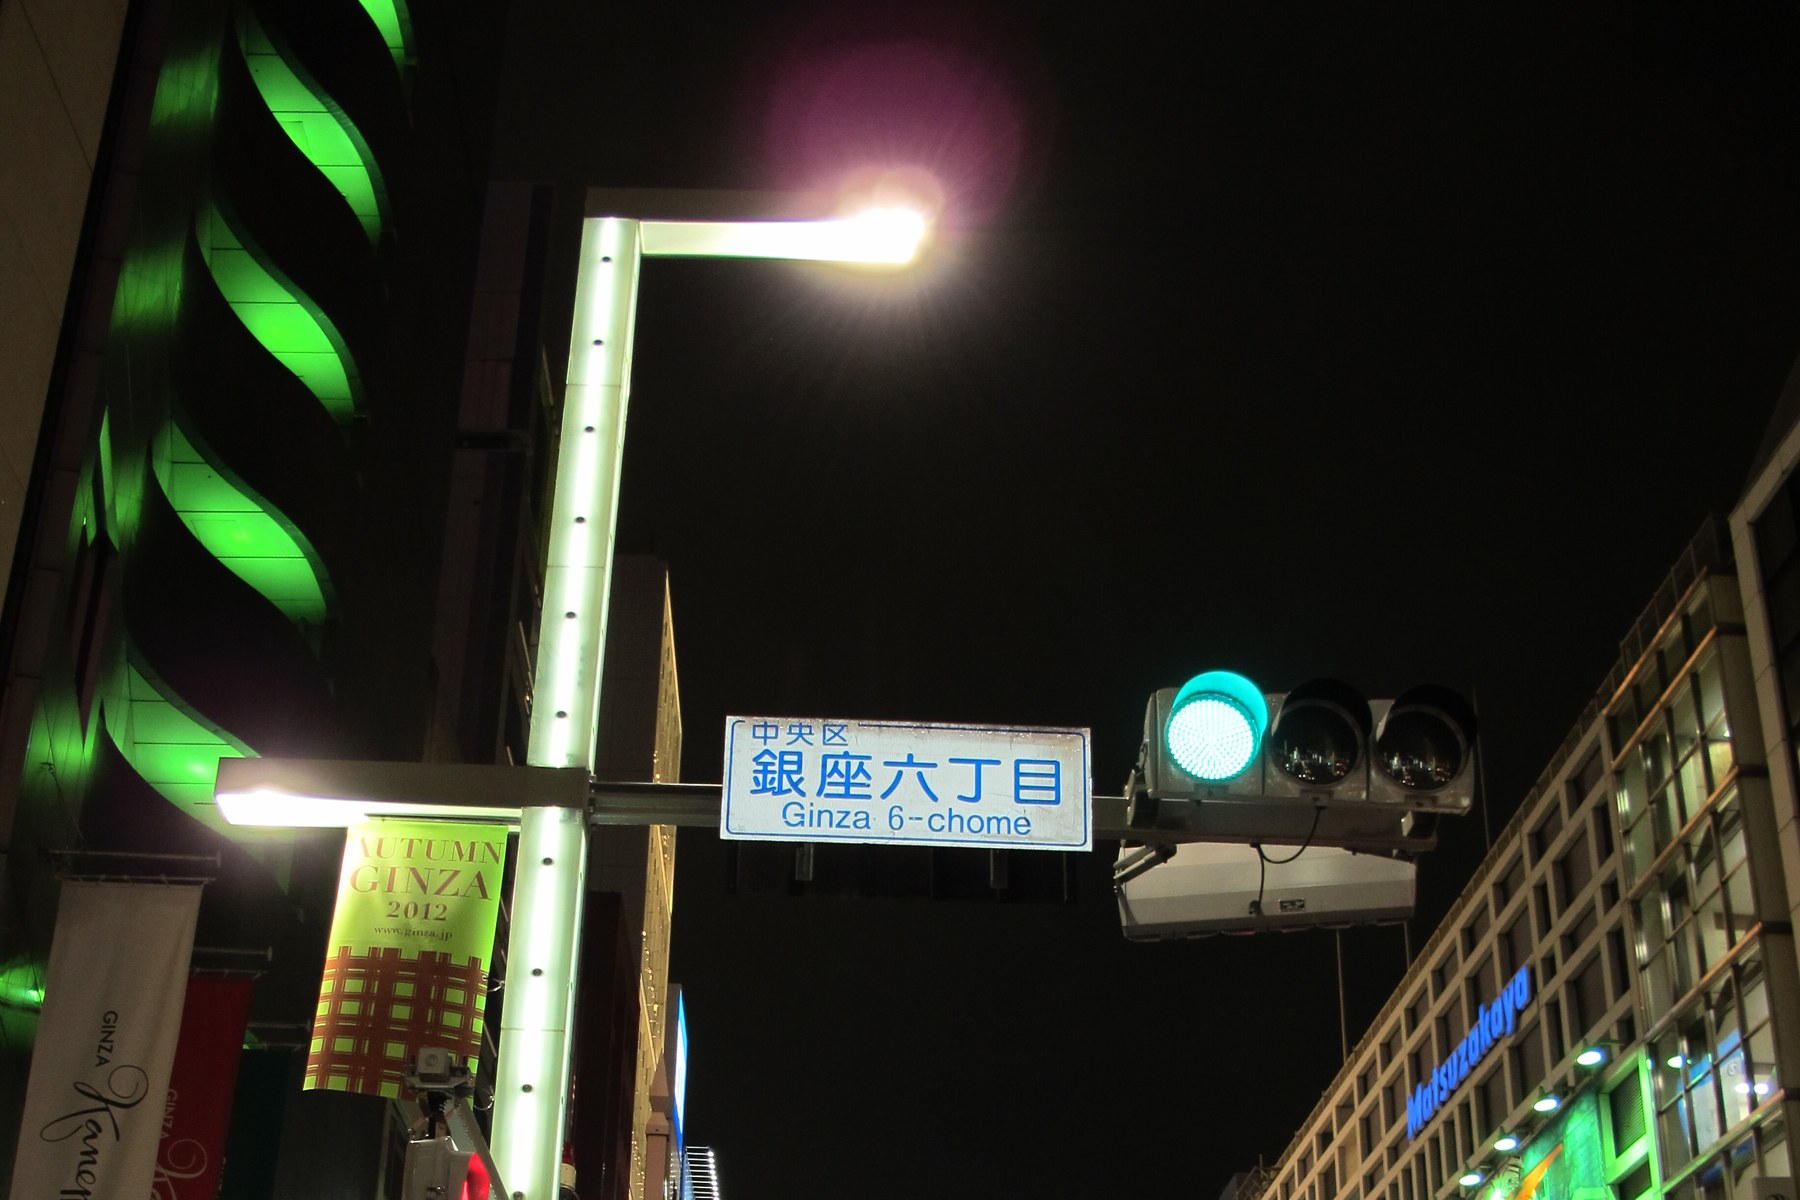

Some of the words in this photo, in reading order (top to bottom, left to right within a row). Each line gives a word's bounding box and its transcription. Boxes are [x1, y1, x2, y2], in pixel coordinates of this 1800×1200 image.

[752, 722, 849, 746] 中央区
[750, 747, 1061, 806] 銀座六丁目
[781, 801, 871, 829] Ginza
[888, 805, 1032, 836] 6-chome
[360, 837, 505, 864] AUTUMN
[351, 865, 492, 900] GINZA
[387, 901, 448, 921] 2012
[374, 926, 453, 940] www.ginza.jp
[95, 1010, 119, 1068] GINZA
[1407, 964, 1529, 1141] Matsuzakaya
